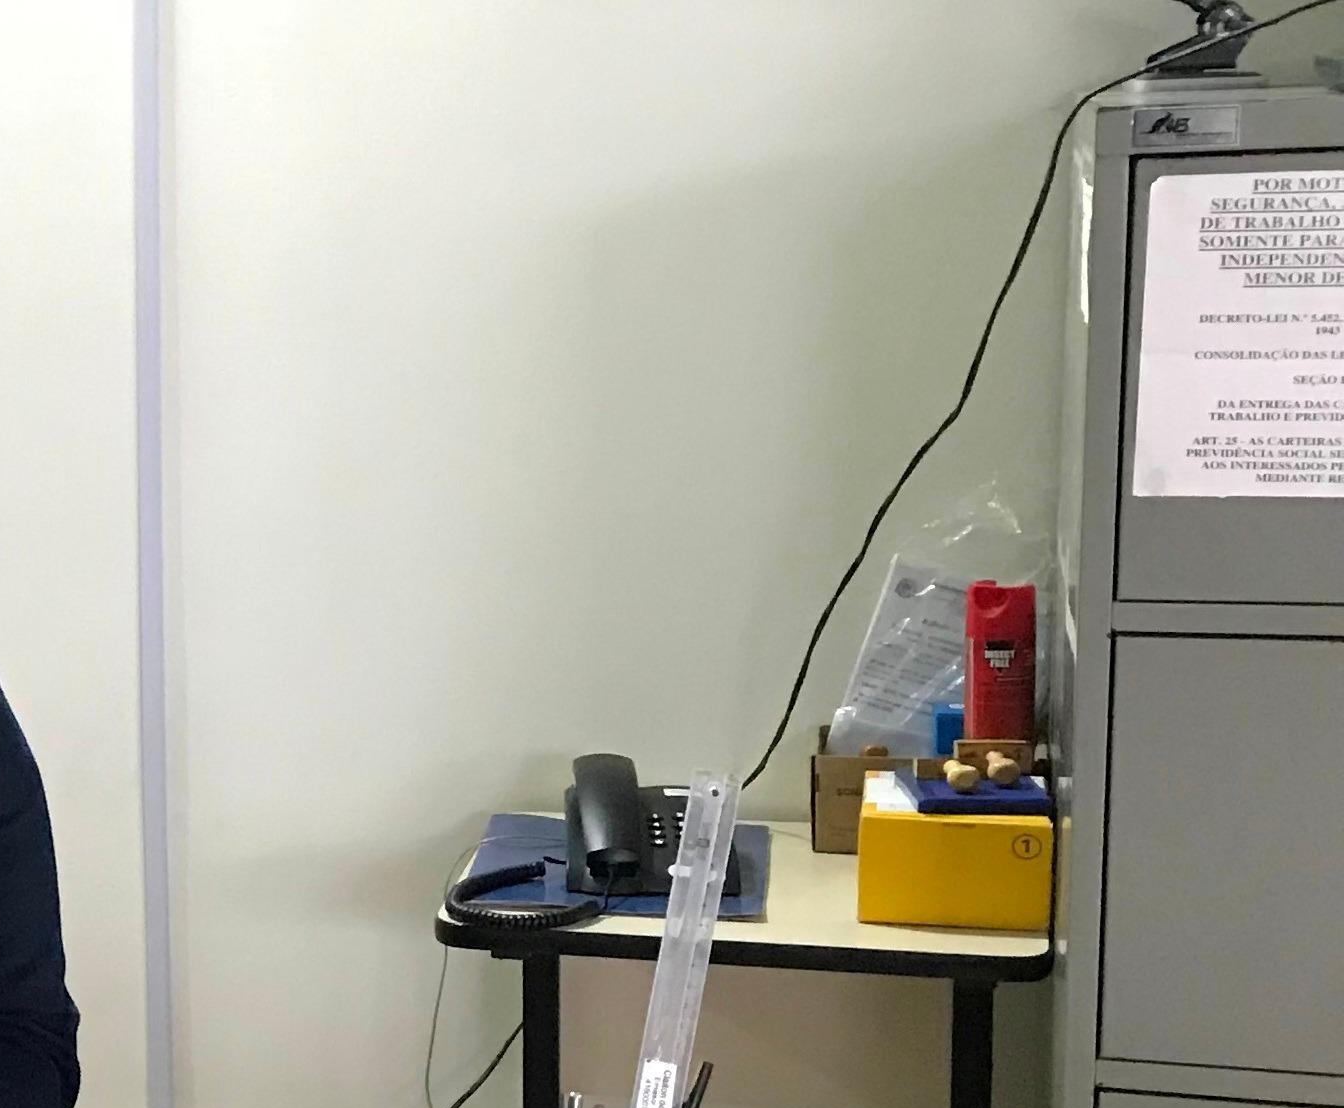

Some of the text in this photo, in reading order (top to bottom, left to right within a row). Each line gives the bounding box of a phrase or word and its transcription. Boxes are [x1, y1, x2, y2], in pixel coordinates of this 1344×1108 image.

[1253, 178, 1292, 191] POR
[1211, 197, 1336, 211] SEGURANÇA,
[1200, 215, 1340, 229] DE TRABALHO
[1199, 235, 1294, 247] SOMENTE
[1244, 272, 1315, 284] MENOR
[1199, 314, 1288, 323] DECRETO-LEI
[1316, 326, 1341, 335] 1943
[1194, 349, 1299, 361] CONSOLIDAÇÃO
[1302, 351, 1328, 360] DAS
[1293, 374, 1337, 386] SEÇÃO
[1217, 400, 1235, 409] DA
[1239, 400, 1301, 409] ENTREGA
[1304, 400, 1330, 409] DAS
[1208, 412, 1280, 421] TRABALHO
[1284, 412, 1292, 421] E
[1193, 437, 1222, 446] ART.
[1225, 437, 1238, 446] 25
[1248, 437, 1264, 446] AS
[1267, 437, 1342, 446] CARTEIRAS
[1186, 447, 1274, 458] PREVIDÊNCIA
[1277, 450, 1326, 459] SOCIAL
[1201, 461, 1227, 470] AOS
[1230, 461, 1328, 471] INTERESSADOS
[1255, 473, 1325, 483] MEDIANTE
